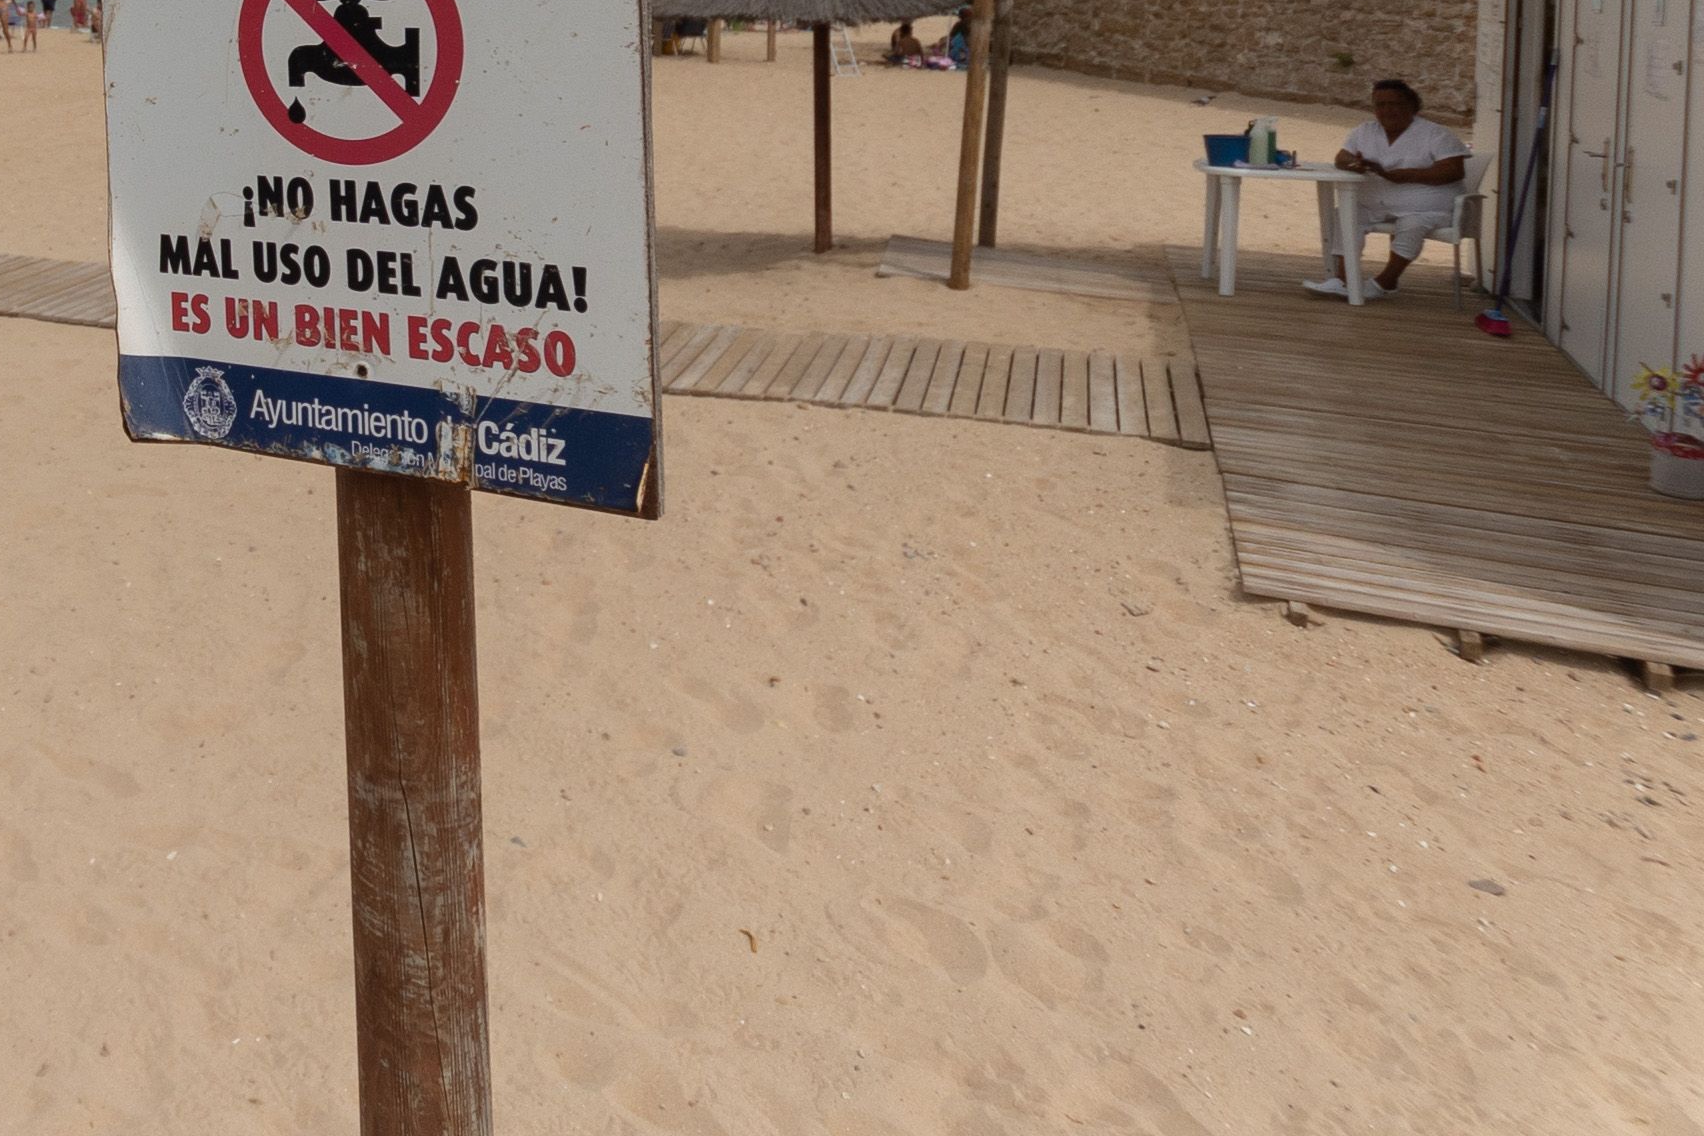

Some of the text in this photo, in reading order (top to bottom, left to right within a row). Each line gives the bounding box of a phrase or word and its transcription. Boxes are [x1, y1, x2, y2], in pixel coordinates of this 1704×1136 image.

[242, 175, 478, 231] ¡NO HAGAS
[159, 234, 588, 314] MAL USO DEL AGUA!
[171, 291, 577, 378] ES UN BIEN ESCASO
[251, 389, 429, 444] Ayuntamiento
[477, 420, 567, 466] Cádiz
[498, 464, 516, 483] de
[518, 466, 567, 492] Playas
